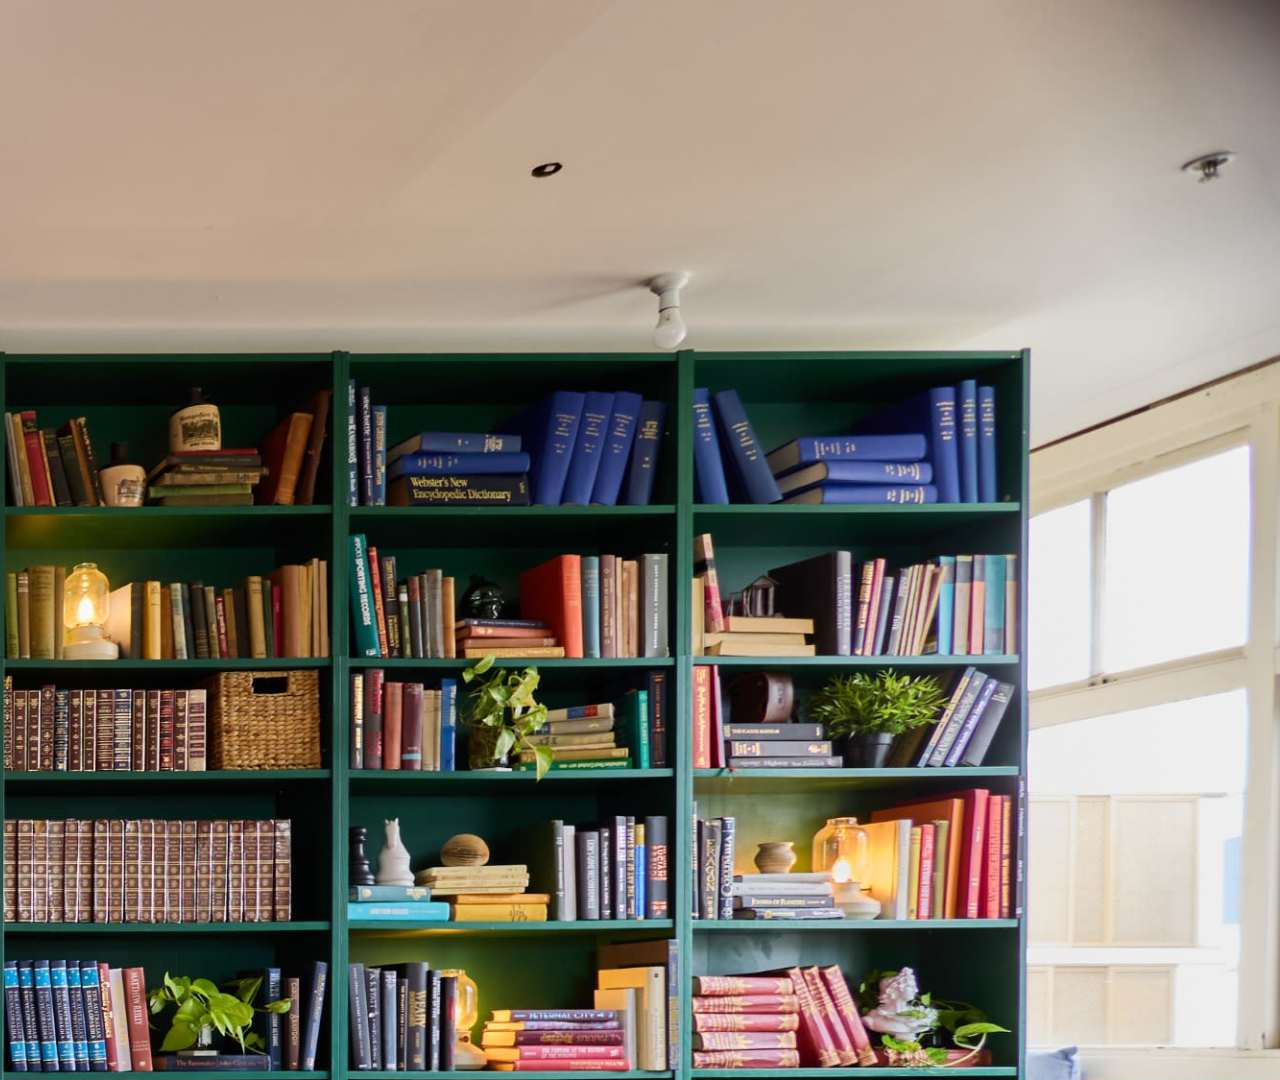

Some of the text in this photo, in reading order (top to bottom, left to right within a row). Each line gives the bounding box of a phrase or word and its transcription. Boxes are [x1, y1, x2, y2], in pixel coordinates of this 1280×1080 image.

[451, 478, 468, 487] New
[468, 489, 511, 501] Dictionary
[415, 991, 426, 1028] WEARY
